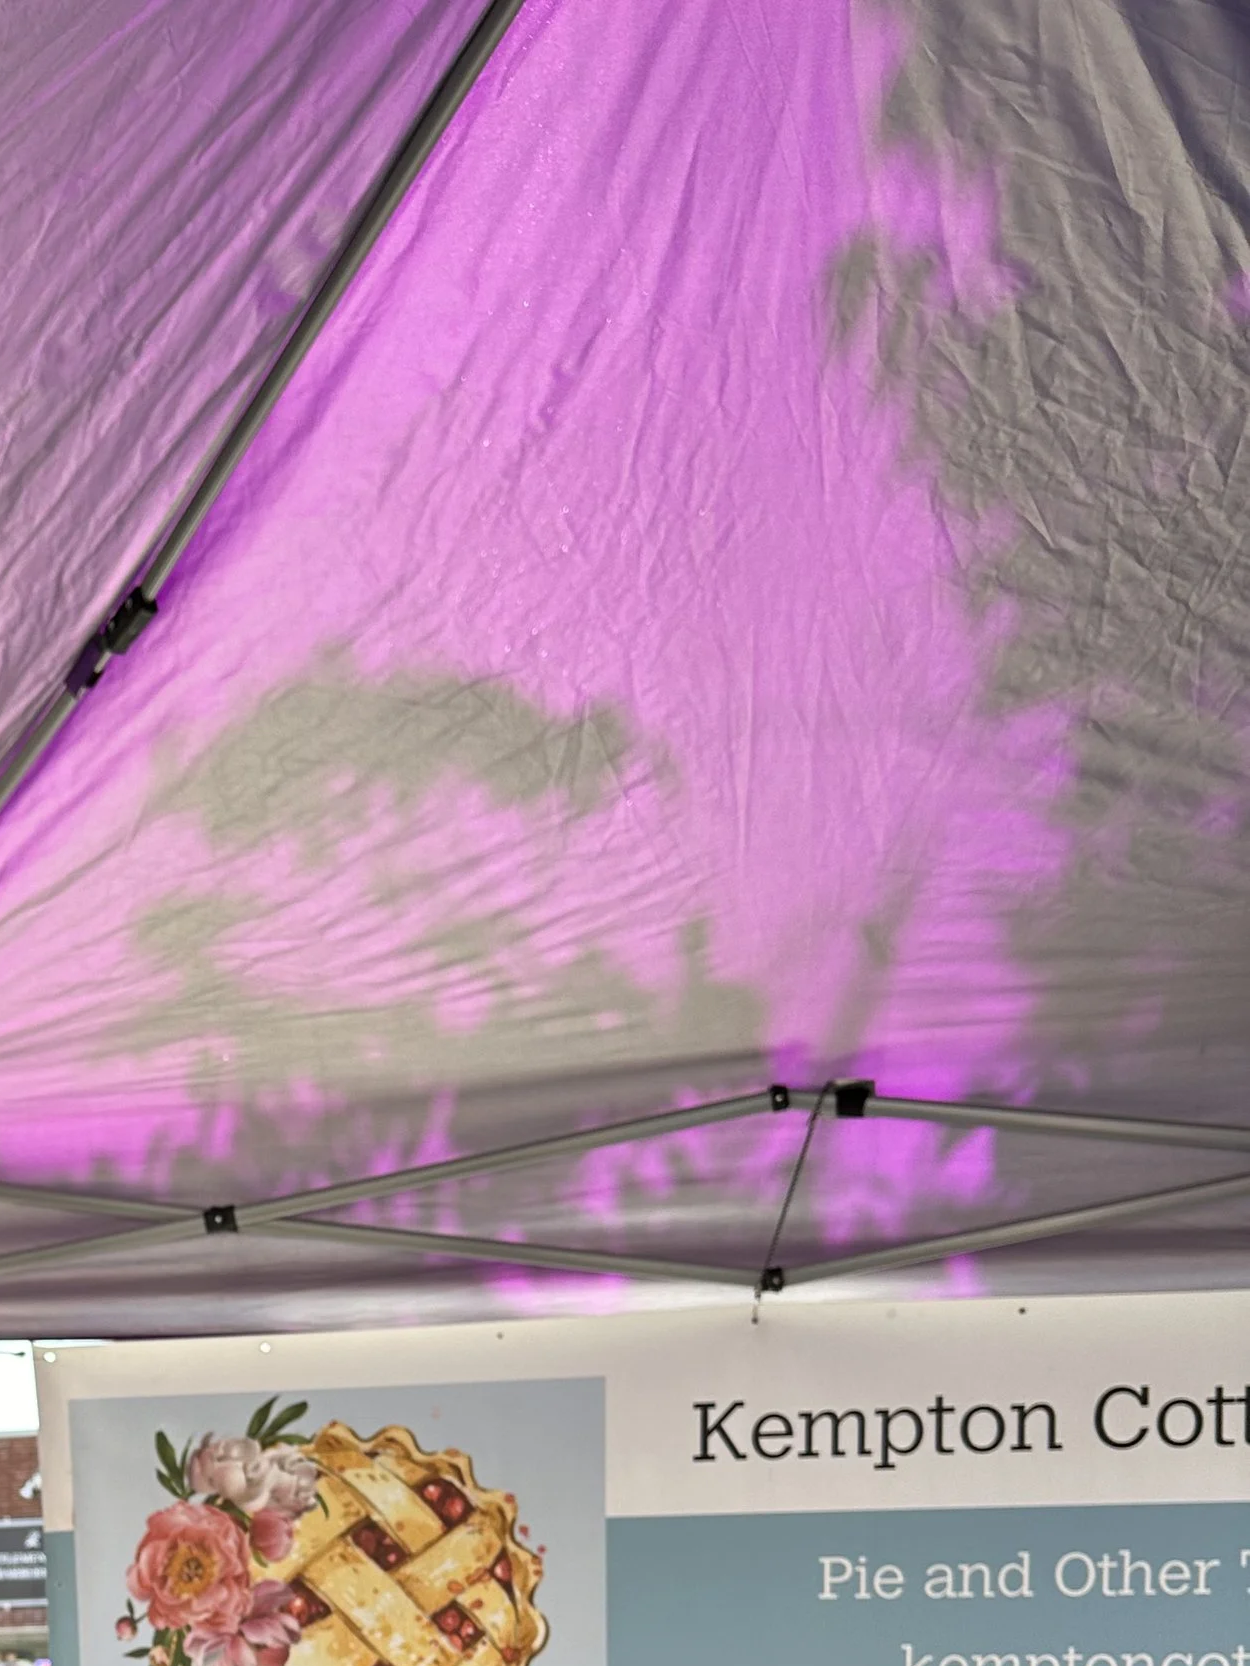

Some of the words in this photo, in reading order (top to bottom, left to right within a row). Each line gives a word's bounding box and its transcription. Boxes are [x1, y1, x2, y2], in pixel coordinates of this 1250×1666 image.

[693, 1395, 1063, 1470] Kempton
[818, 1555, 904, 1600] Pie
[924, 1551, 1034, 1599] and
[1054, 1550, 1221, 1598] Other
